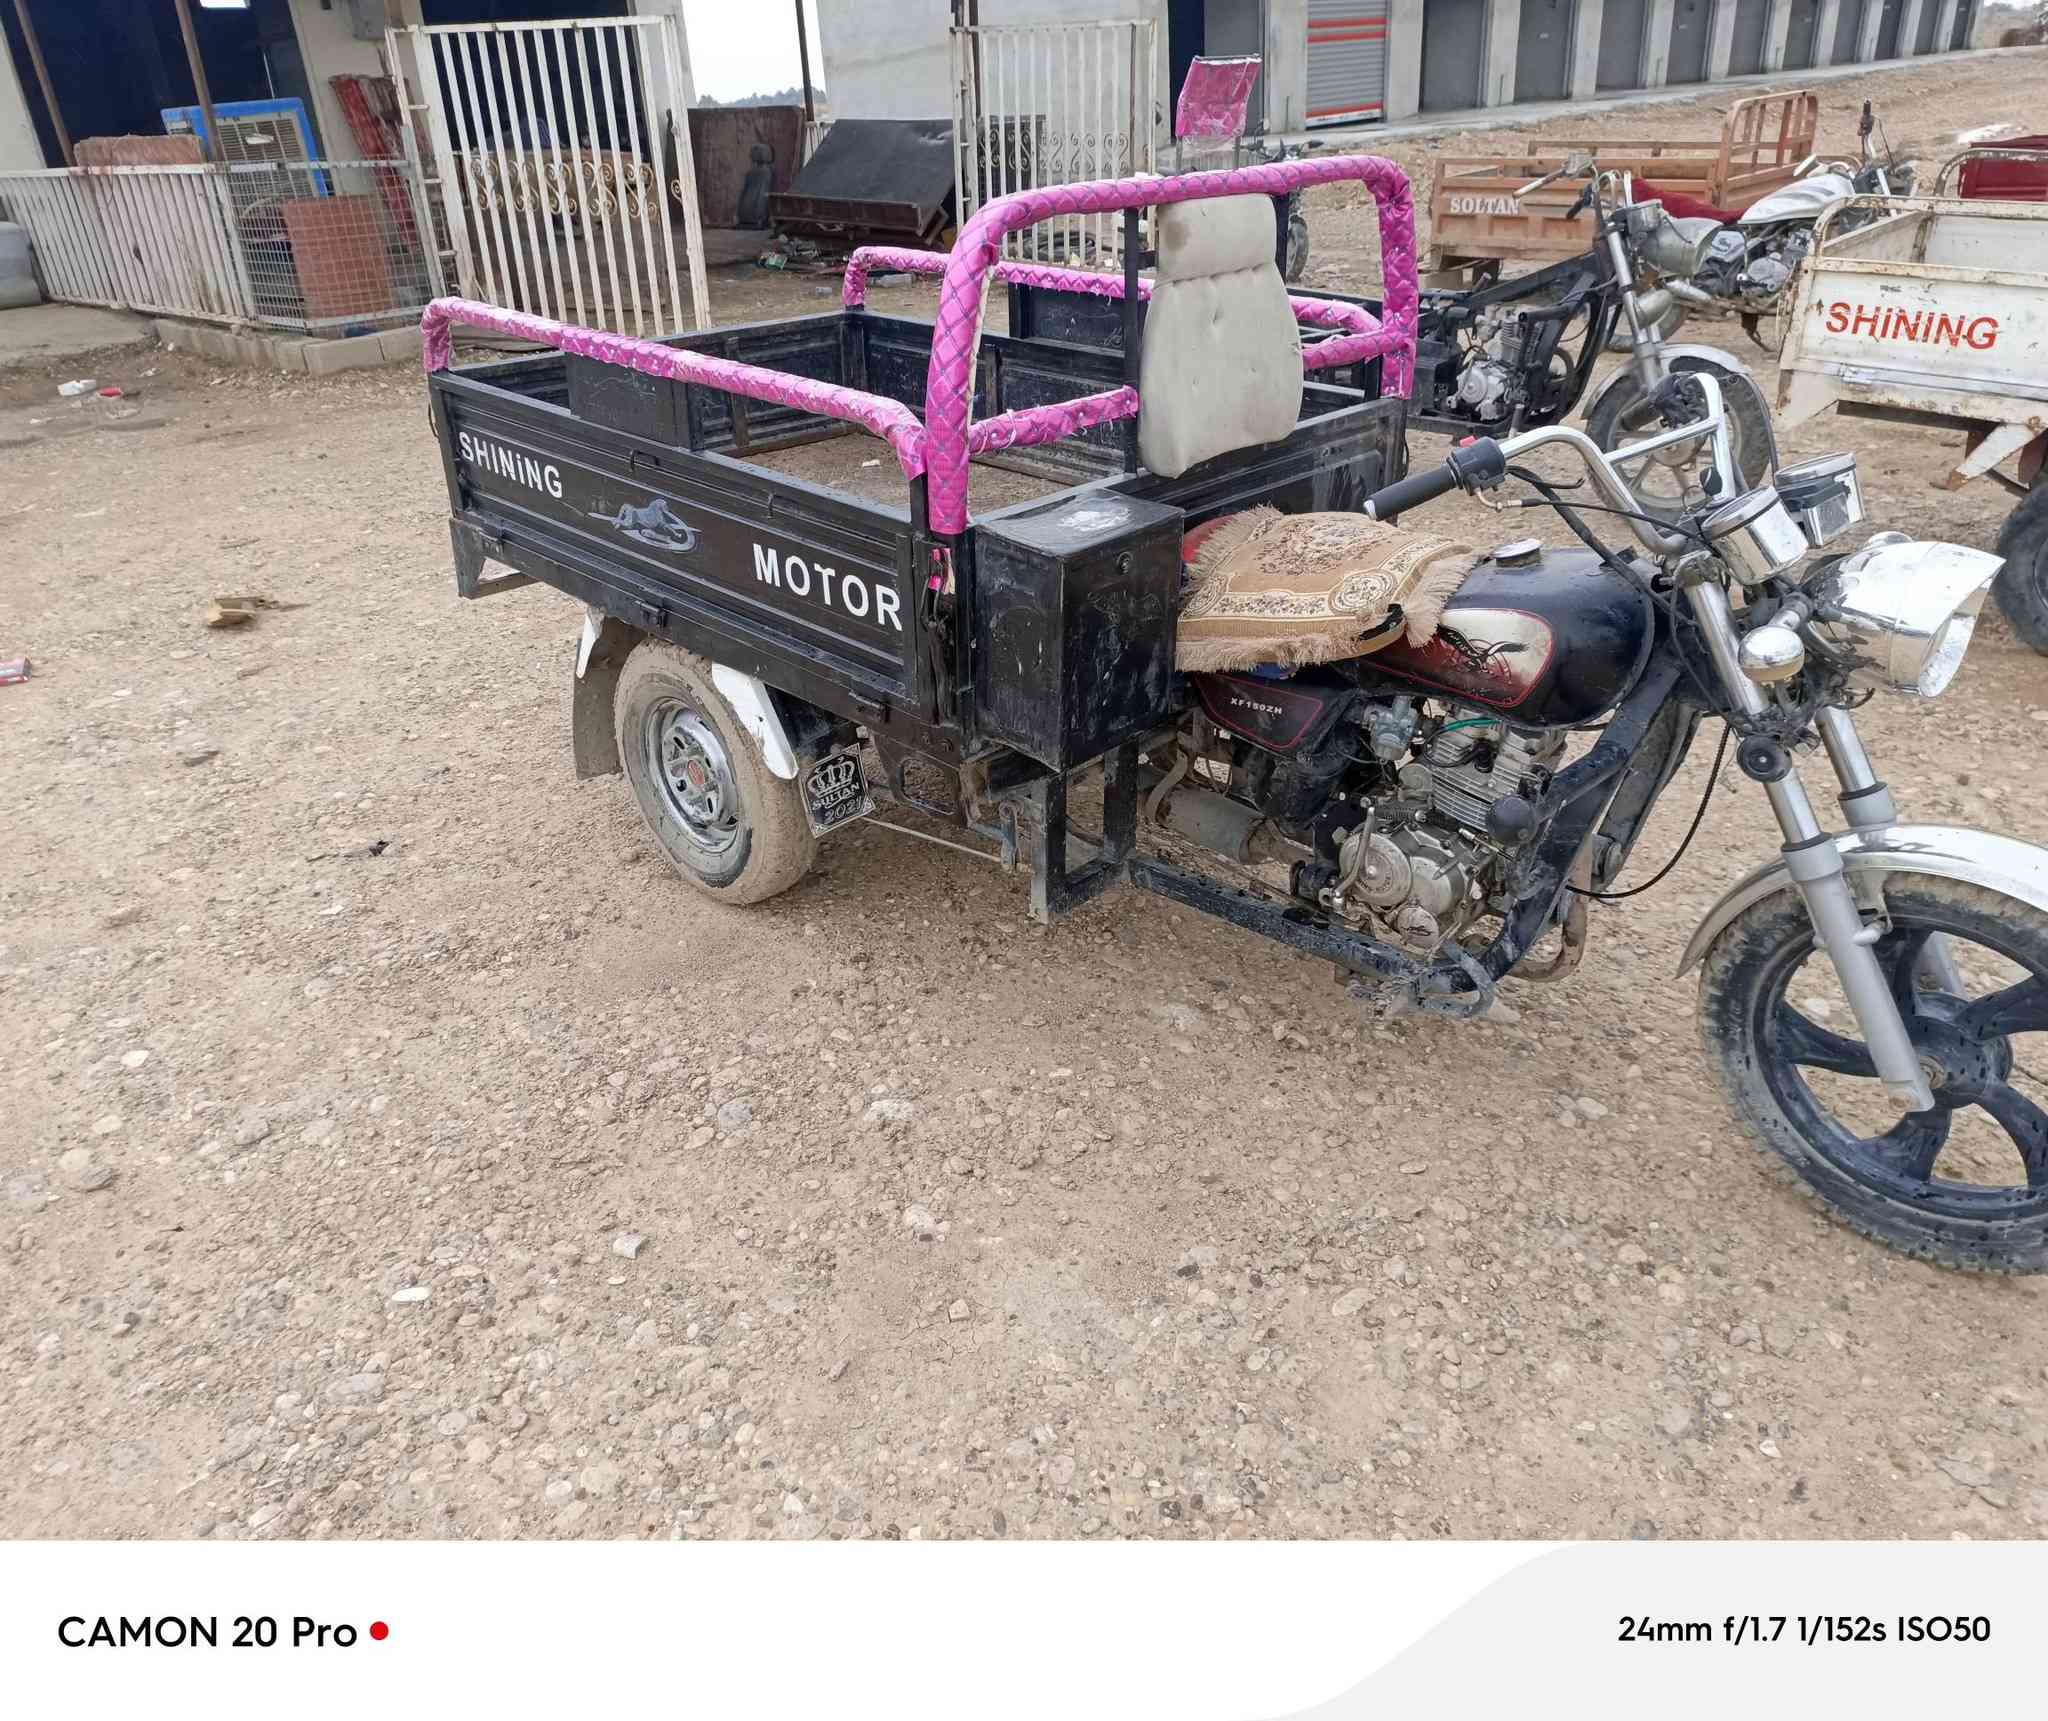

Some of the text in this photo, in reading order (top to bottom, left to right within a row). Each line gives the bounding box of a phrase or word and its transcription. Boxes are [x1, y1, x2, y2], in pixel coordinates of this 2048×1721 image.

[1450, 197, 1521, 216] SOLTAN
[752, 542, 904, 632] MOTOR
[1230, 697, 1283, 715] XF150ZH
[812, 782, 860, 811] SULTAN
